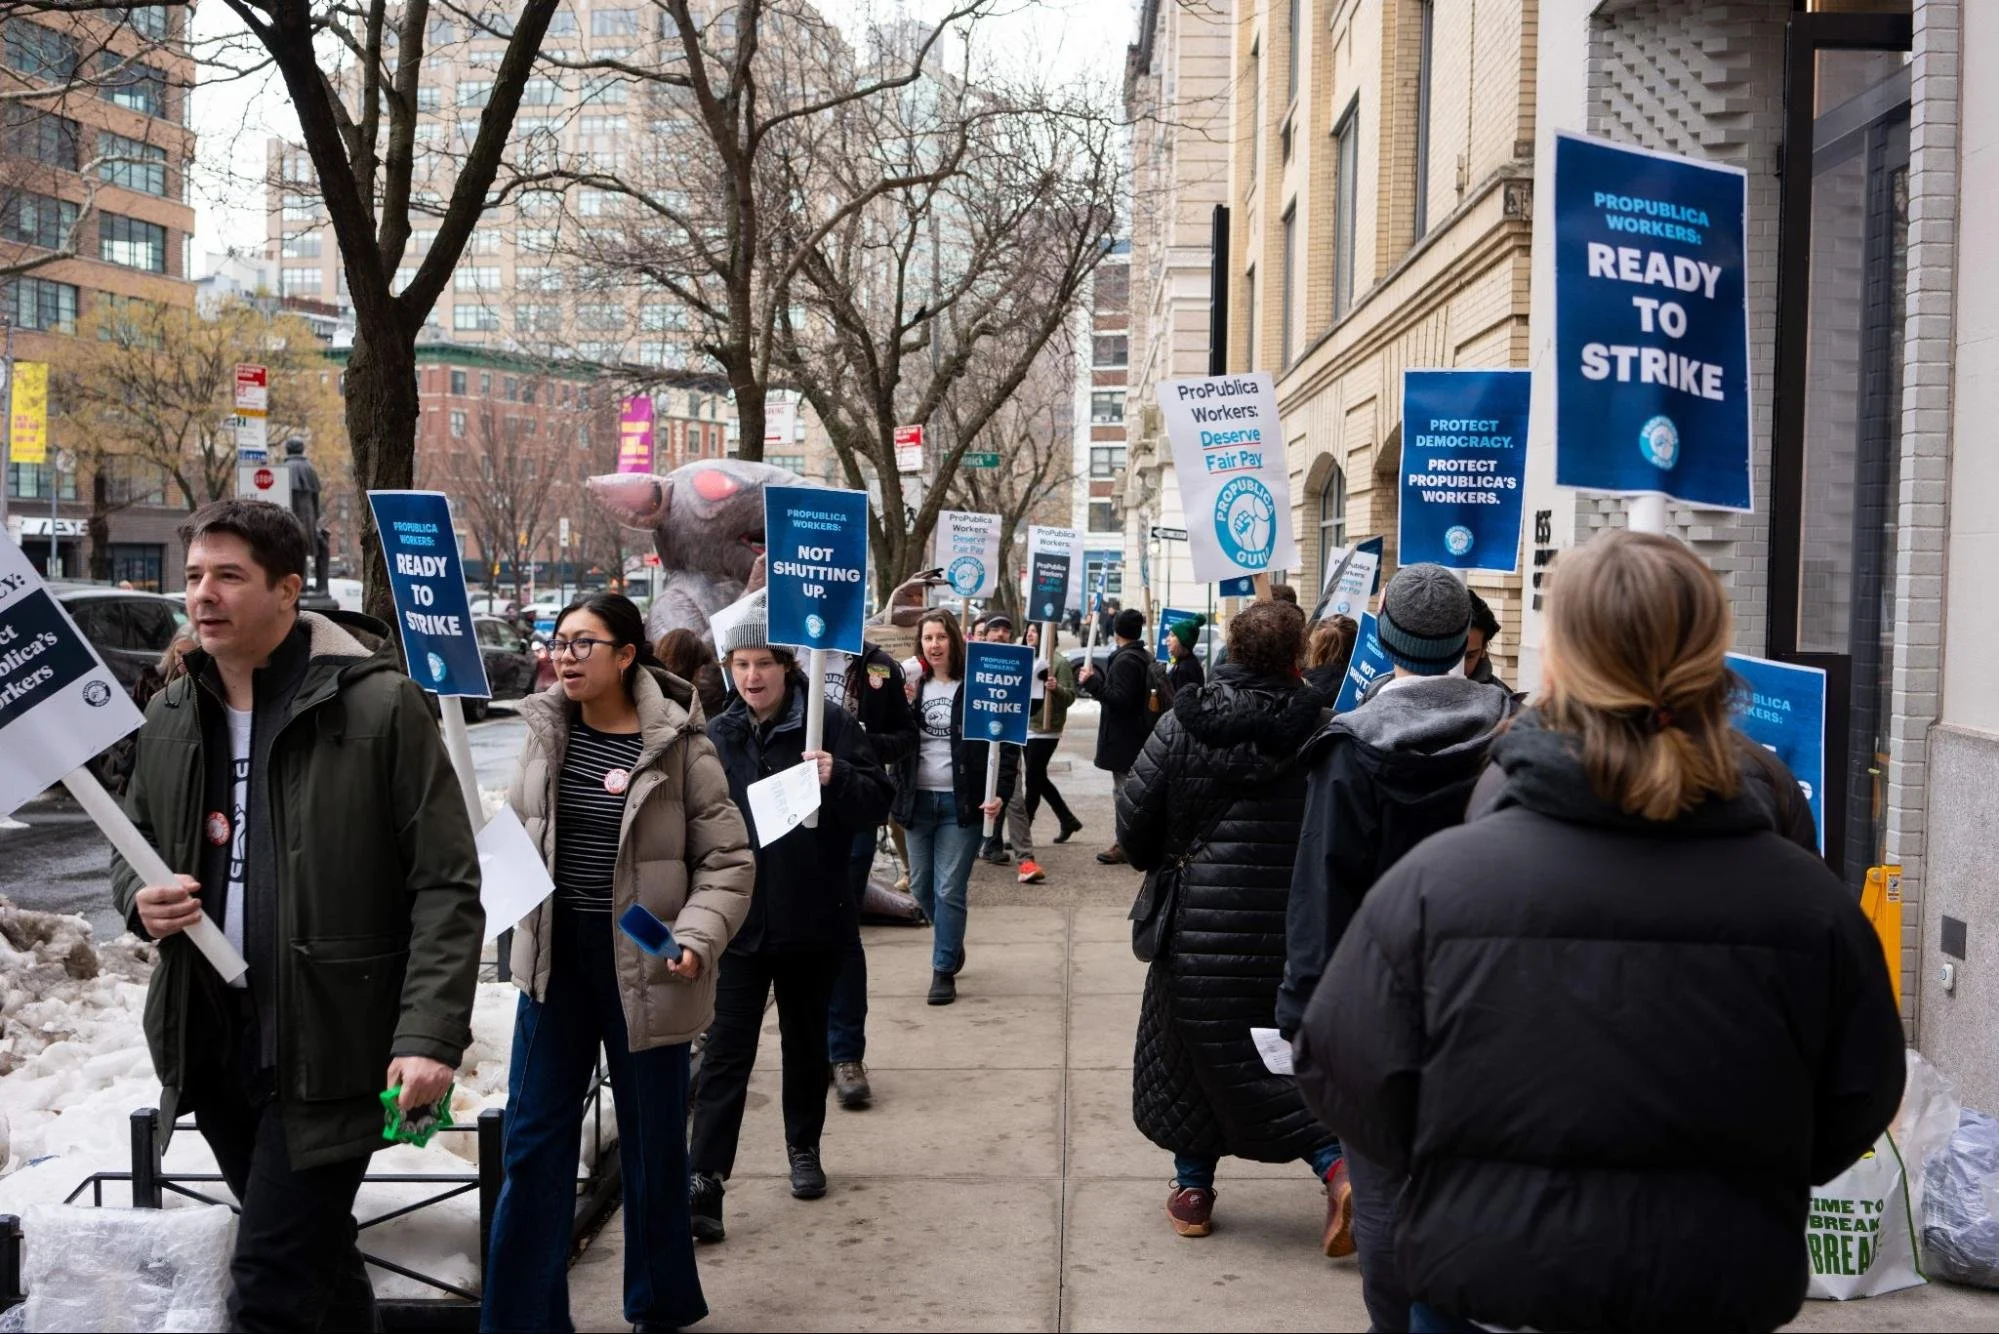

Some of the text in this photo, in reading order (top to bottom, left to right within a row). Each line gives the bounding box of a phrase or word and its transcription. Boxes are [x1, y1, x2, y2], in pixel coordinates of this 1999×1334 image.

[1593, 191, 1710, 227] PROPUBLICA
[1606, 214, 1703, 245] WORKERS:
[1587, 242, 1721, 299] READY
[1632, 296, 1687, 339] TO
[1581, 343, 1724, 401] STRIKE
[1177, 380, 1259, 400] ProPublica
[1192, 404, 1259, 423] Workers:
[1430, 419, 1499, 432] PROTECT
[1200, 428, 1261, 447] Deserve
[1416, 435, 1514, 449] DEMOCRACY.
[1205, 450, 1263, 471] Fair Pay
[1428, 459, 1497, 472] PROTECT
[1408, 474, 1517, 489] PROPUBLICA'S
[1216, 479, 1274, 522] PROPUBLICA
[1422, 490, 1500, 504] WORKERS.
[787, 509, 847, 521] PROPUBLICA
[949, 513, 992, 524] ProPublica
[393, 521, 438, 533] PROPUBLICA
[793, 520, 841, 531] WORKERS:
[400, 535, 435, 546] WORKERS:
[798, 545, 834, 561] NOT
[396, 553, 447, 577] READY
[773, 561, 860, 582] SHUTTING
[411, 584, 434, 606] TO
[803, 583, 827, 599] UP.
[405, 611, 463, 636] STRIKE
[1349, 666, 1371, 689] SHUTT
[1360, 660, 1376, 678] NOT
[975, 672, 1022, 686] READY
[988, 688, 1007, 699] TO
[972, 700, 1021, 713] STRIKE
[1860, 1199, 1884, 1214] TO
